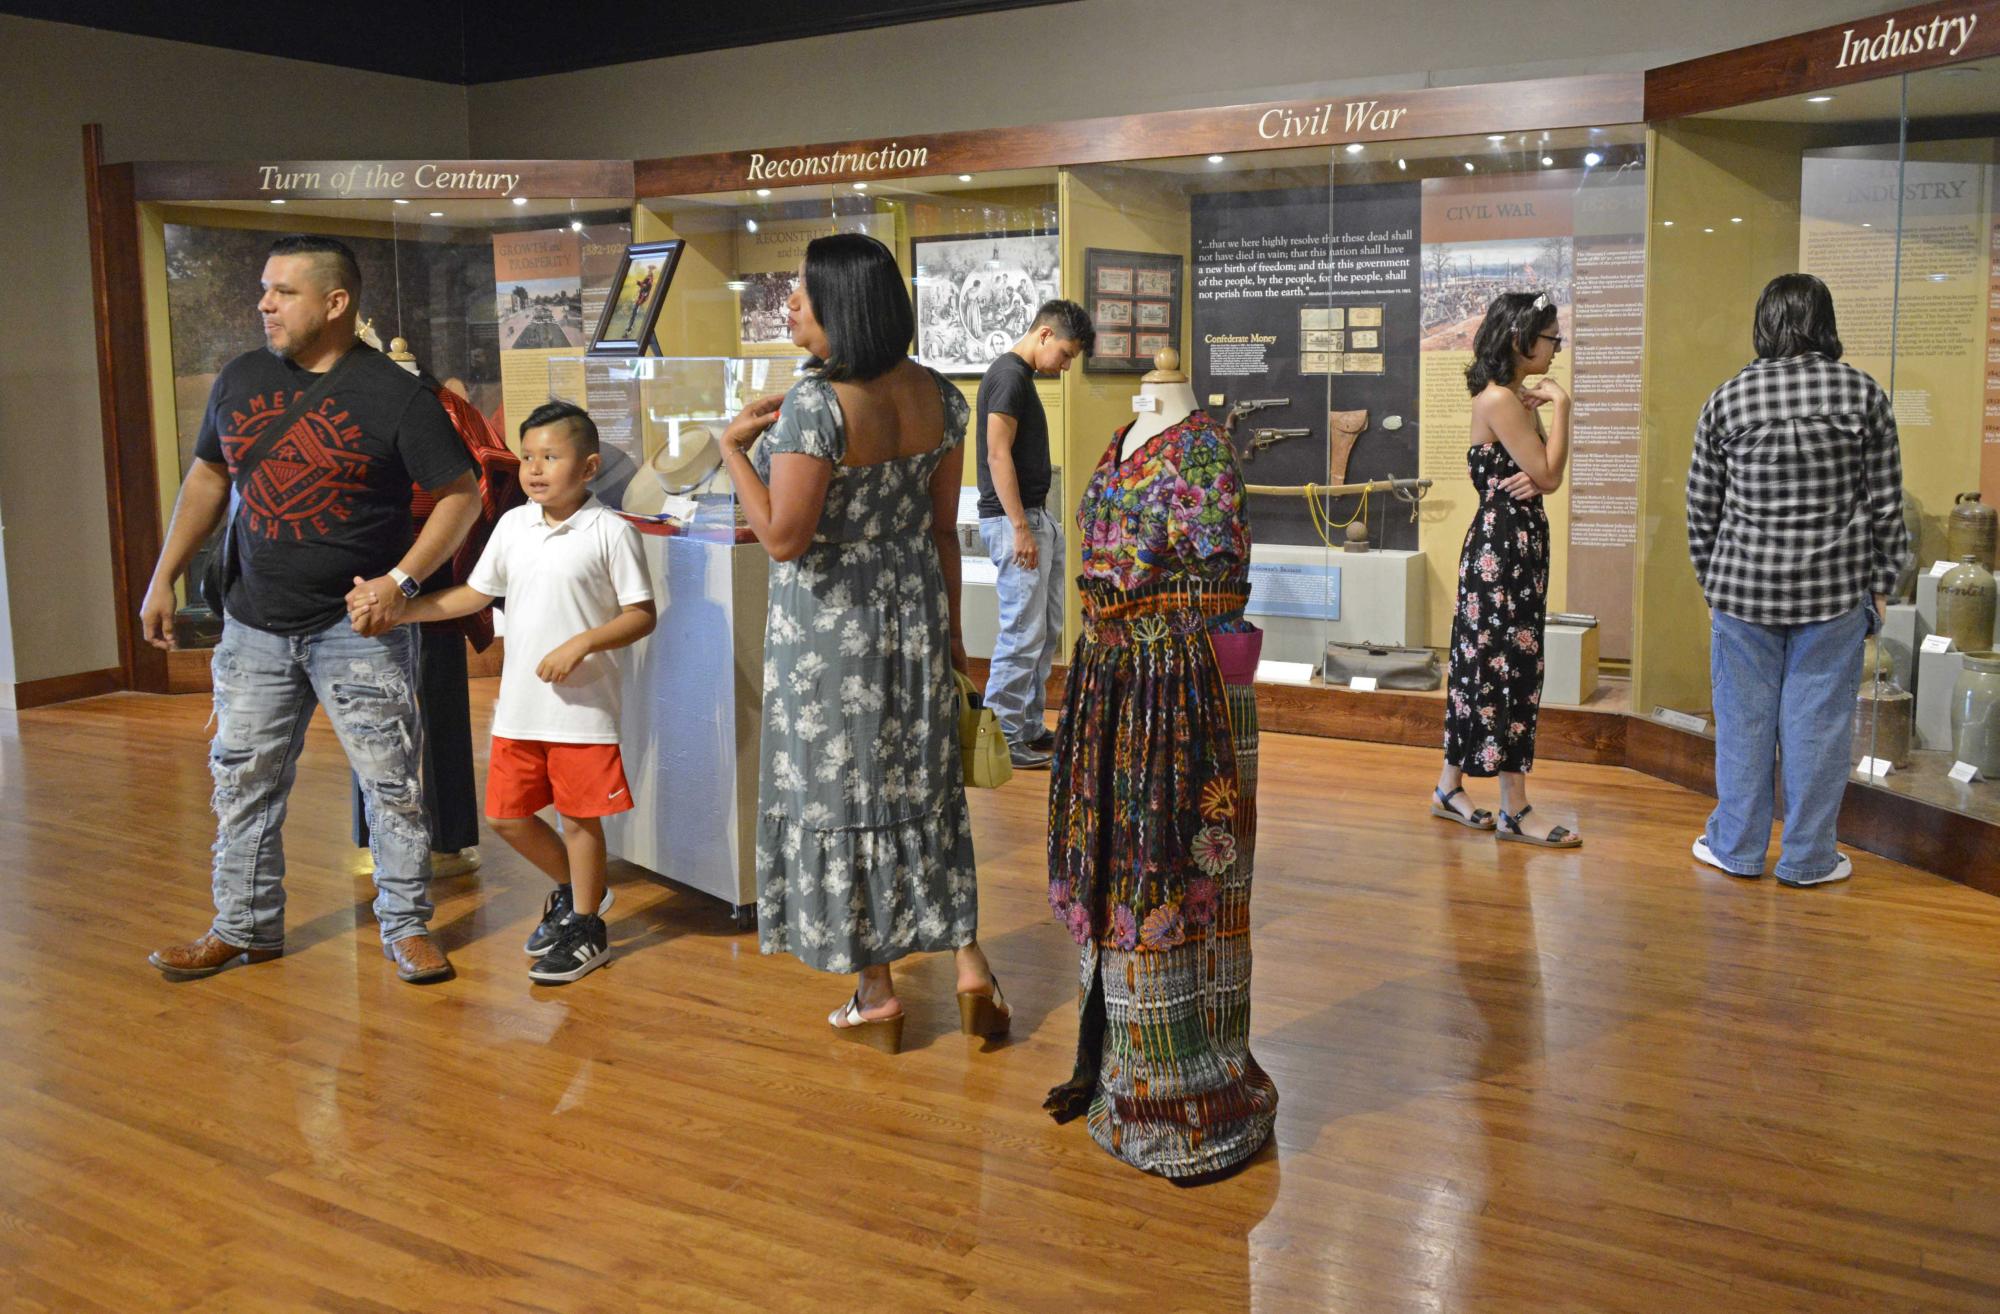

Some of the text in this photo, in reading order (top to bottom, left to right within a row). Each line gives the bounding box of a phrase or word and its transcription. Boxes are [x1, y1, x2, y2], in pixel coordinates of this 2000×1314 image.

[1835, 13, 1978, 69] Industry
[1257, 100, 1407, 140] Civil War
[746, 142, 928, 181] Reconstruction
[258, 164, 520, 196] Turn of the Century
[1847, 180, 1967, 203] INDUSTRY
[1446, 202, 1536, 221] CIVIL WAR
[1227, 240, 1239, 248] we
[1241, 238, 1260, 247] here
[1262, 237, 1288, 248] highly
[1290, 237, 1320, 245] resolve
[1322, 235, 1340, 244] that
[1342, 234, 1365, 243] these
[1367, 232, 1389, 242] dead
[1391, 230, 1413, 240] shall
[1199, 244, 1404, 262] not have died in vain; that this nation shall have
[1198, 258, 1410, 274] a new birth of freedom; and that this government
[1198, 270, 1407, 288] of the people, by the people, for the people, shall
[1199, 291, 1212, 299] not
[1214, 288, 1241, 300] perish
[1242, 288, 1263, 298] from
[1265, 287, 1279, 297] the
[1205, 333, 1277, 344] Confederate Money
[344, 461, 368, 479] 74
